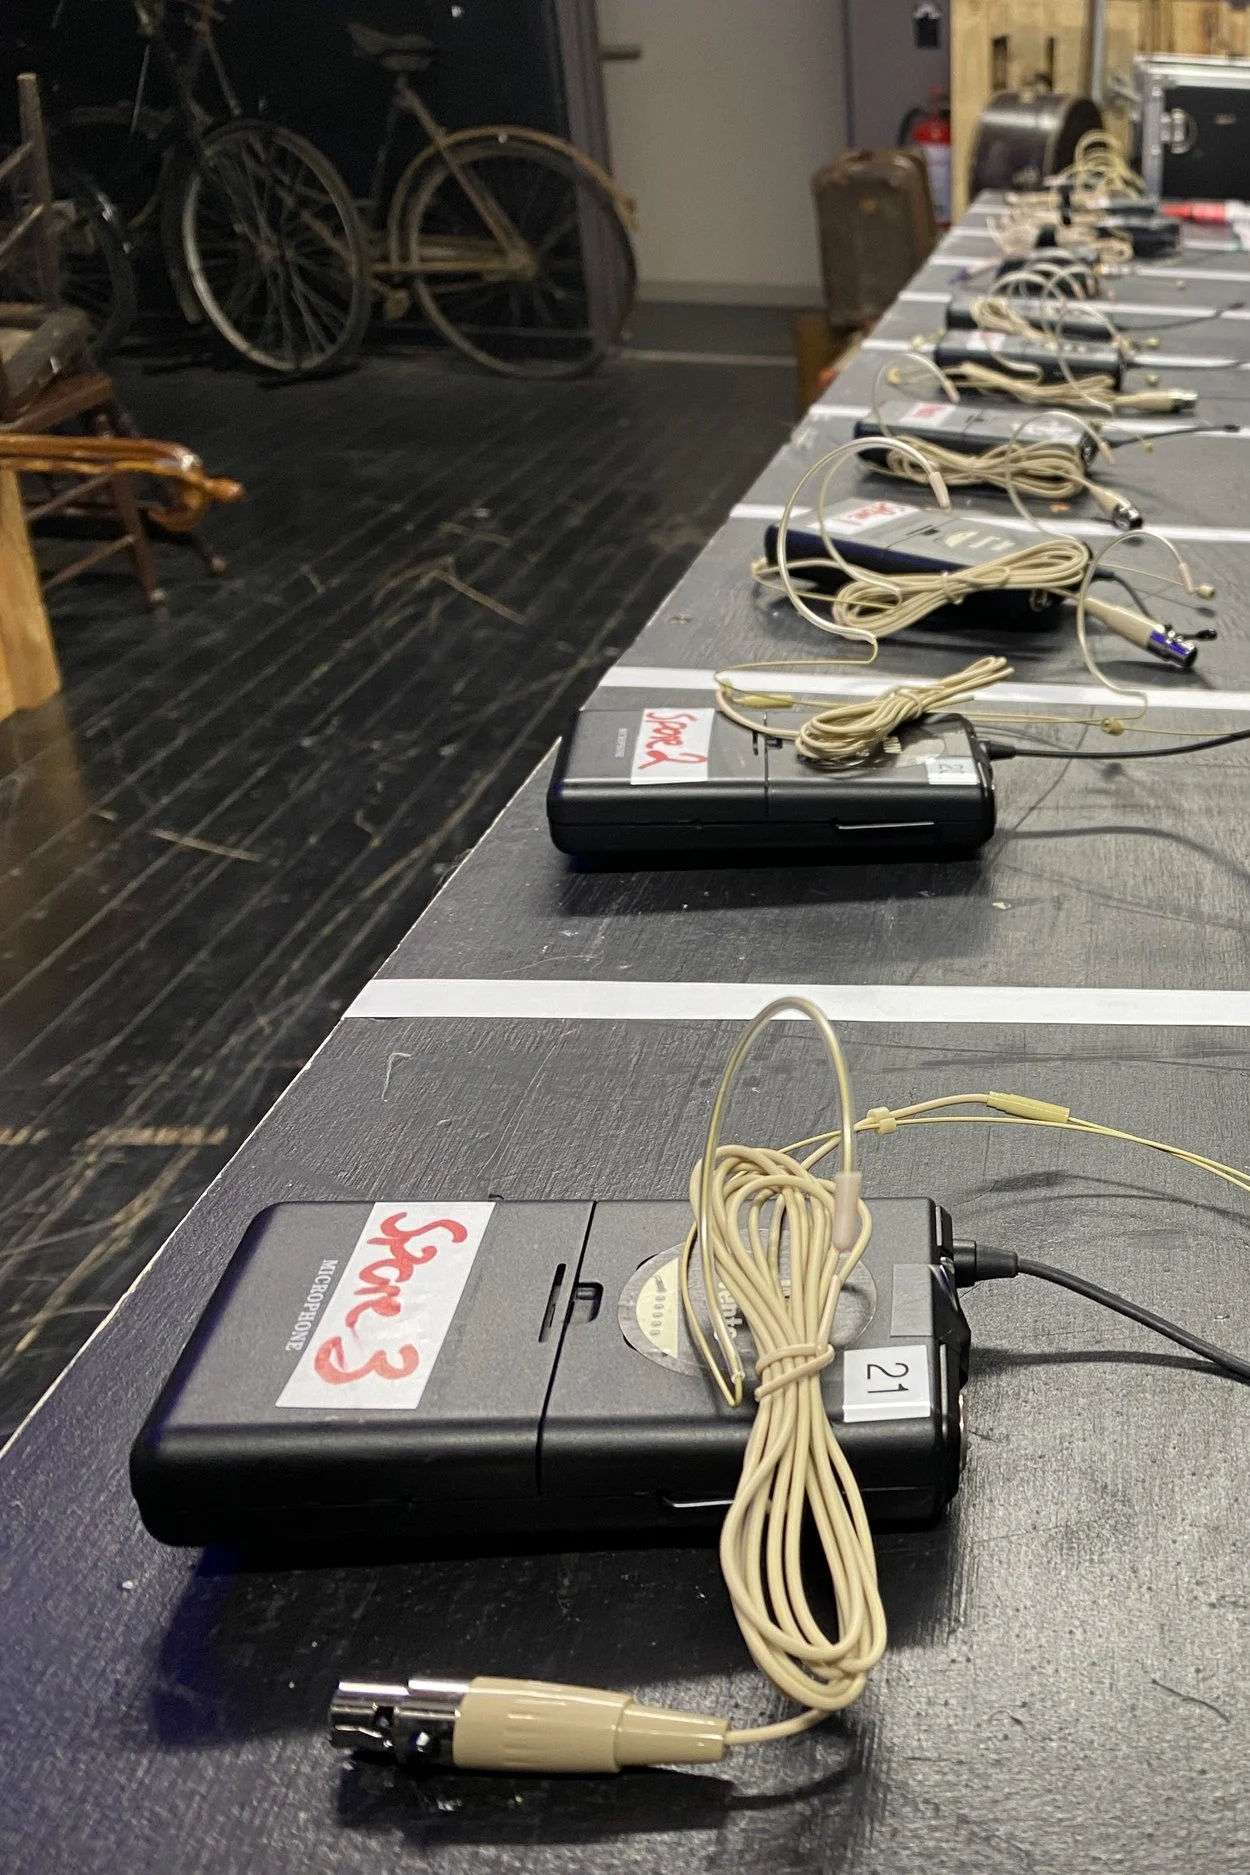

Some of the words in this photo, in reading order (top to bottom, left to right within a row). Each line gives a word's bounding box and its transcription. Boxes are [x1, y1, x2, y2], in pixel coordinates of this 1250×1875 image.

[638, 750, 708, 769] 2
[344, 1211, 469, 1329] Spare
[285, 1258, 339, 1352] MICROPHONE
[313, 1335, 420, 1385] 3
[866, 1362, 910, 1394] 21
